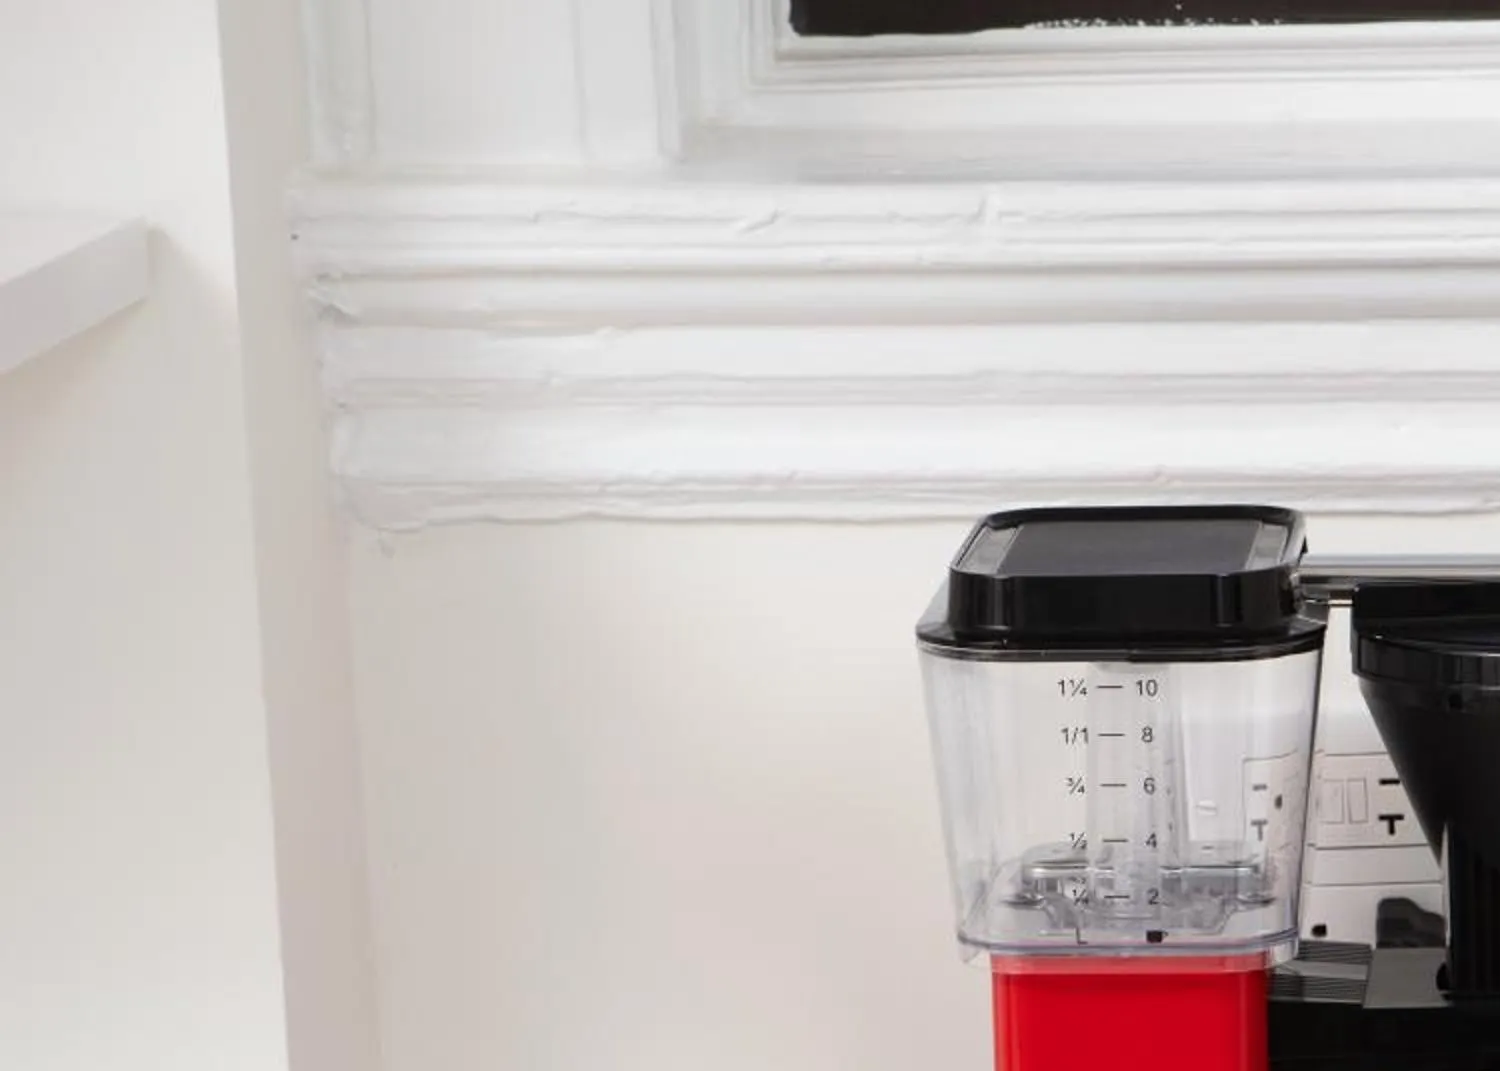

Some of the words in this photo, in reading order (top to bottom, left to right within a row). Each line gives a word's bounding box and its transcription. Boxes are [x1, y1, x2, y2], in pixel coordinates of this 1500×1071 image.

[1136, 679, 1159, 697] 10
[1061, 726, 1089, 745] 1/1
[1141, 726, 1154, 743] 8
[1143, 776, 1156, 795] 6
[1144, 832, 1158, 849] 4
[1146, 887, 1160, 906] 2
